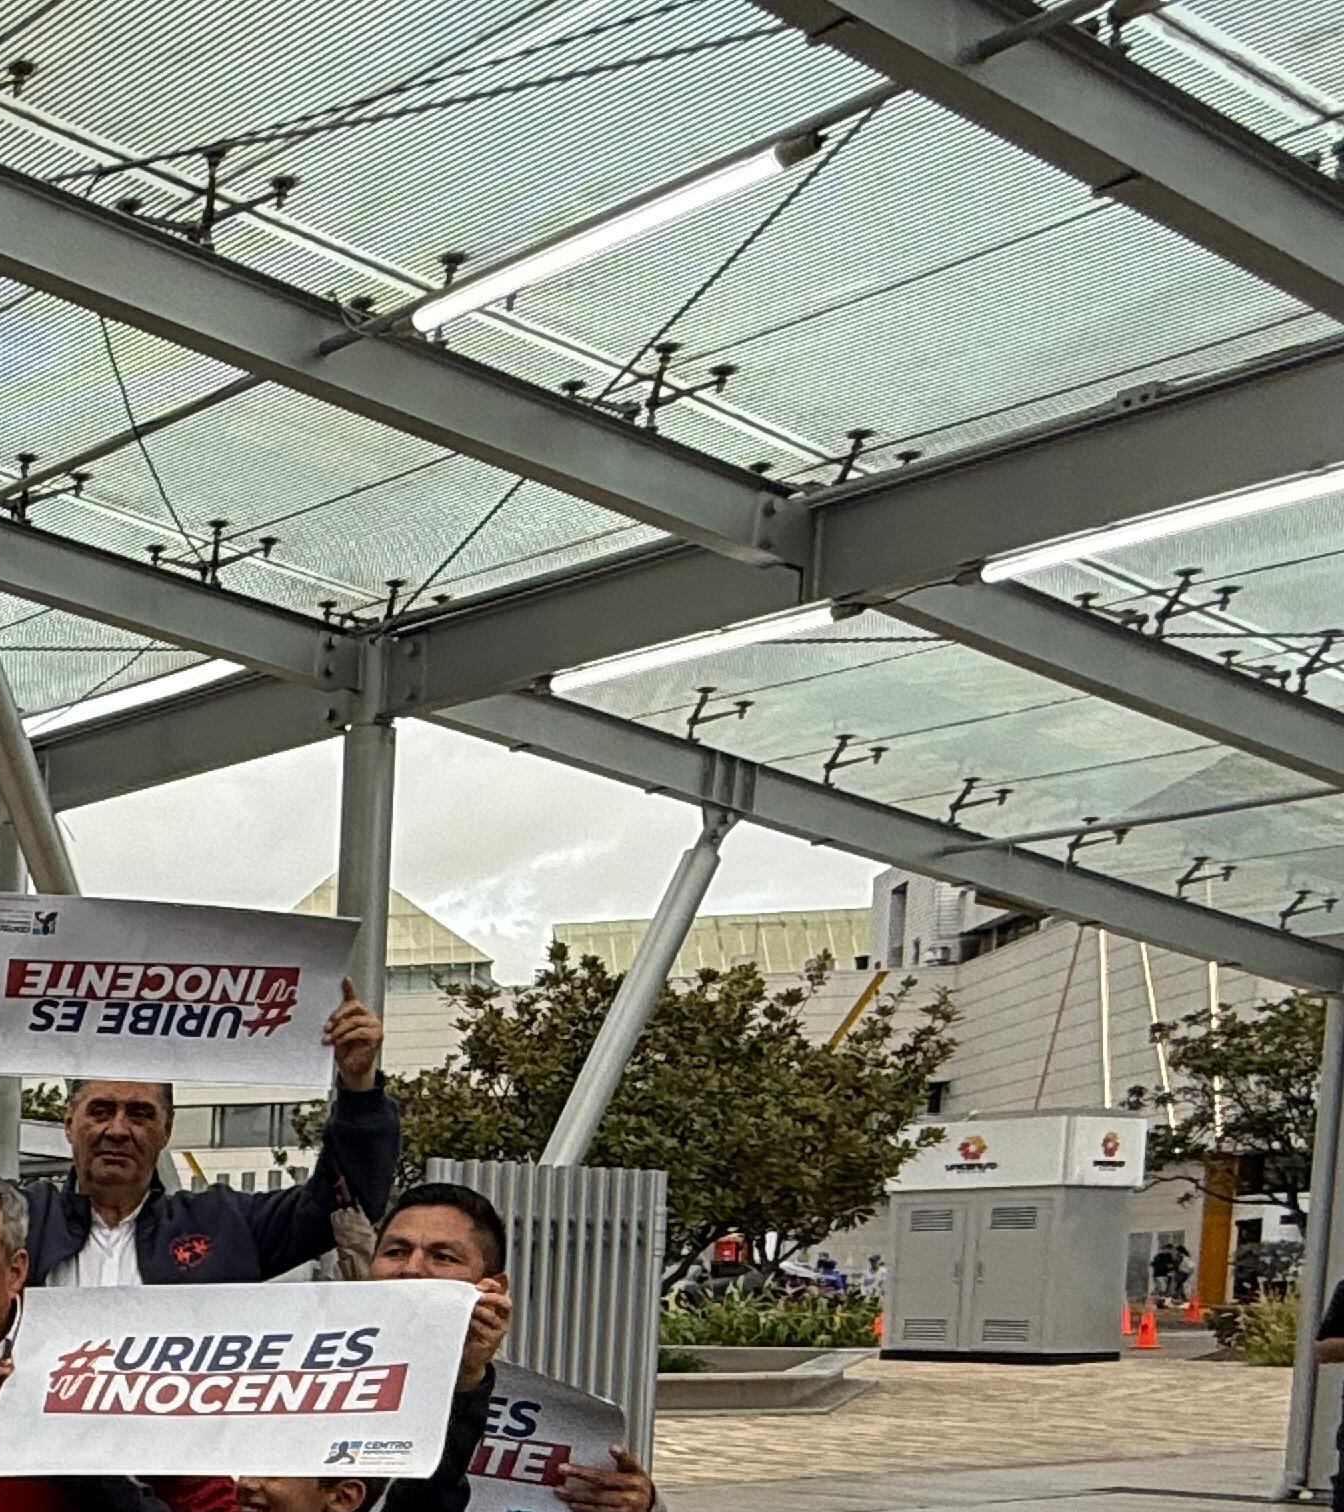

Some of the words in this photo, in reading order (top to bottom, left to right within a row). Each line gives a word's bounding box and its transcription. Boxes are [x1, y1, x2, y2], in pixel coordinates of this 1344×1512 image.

[18, 962, 267, 1003] INOCENTE
[28, 998, 88, 1033] ES
[96, 985, 298, 1038] #URIBE
[48, 1334, 293, 1396] #URIBE
[300, 1327, 380, 1370] ES
[81, 1368, 390, 1413] INOCENTE
